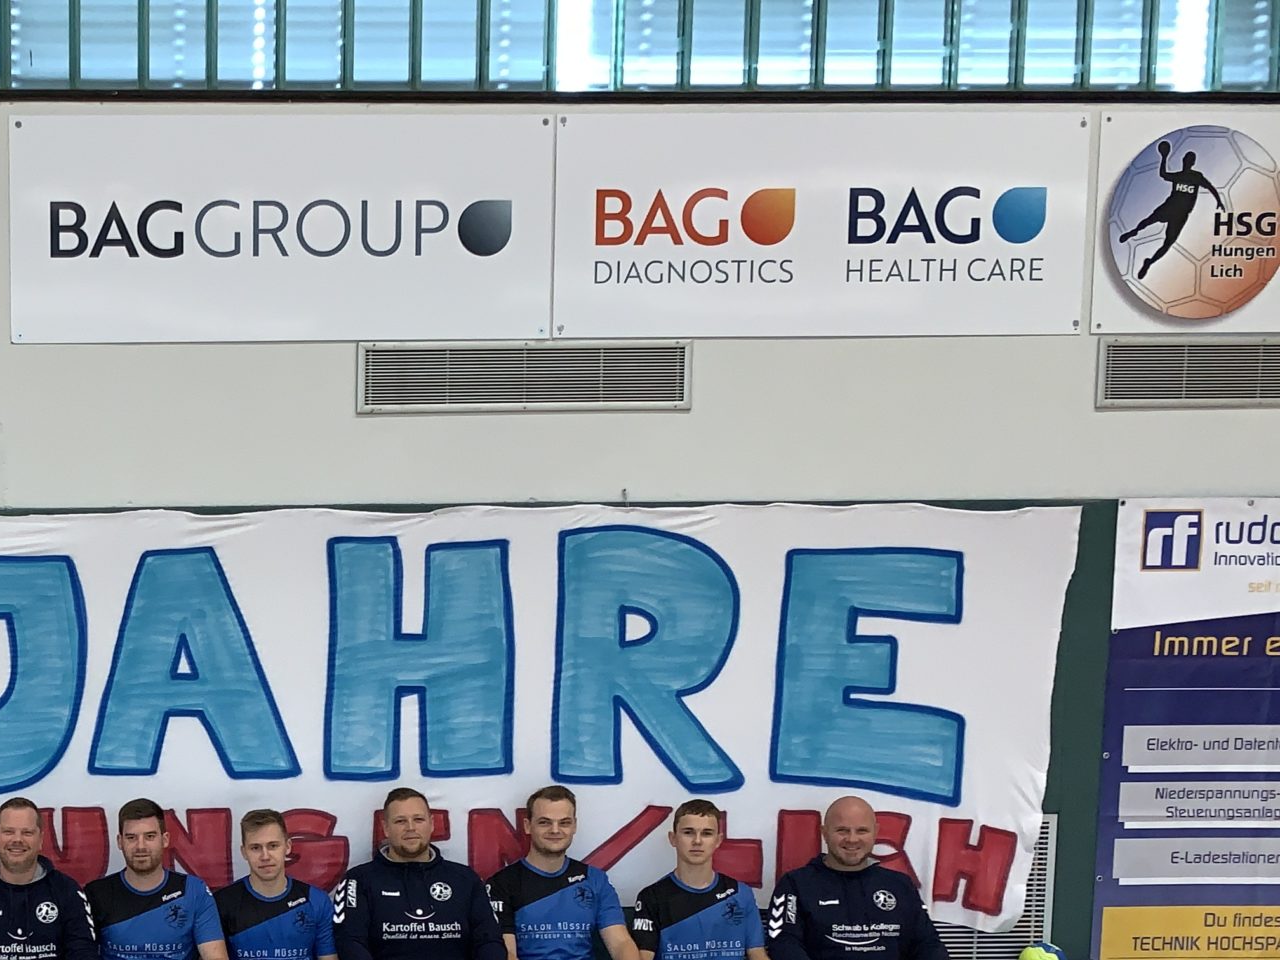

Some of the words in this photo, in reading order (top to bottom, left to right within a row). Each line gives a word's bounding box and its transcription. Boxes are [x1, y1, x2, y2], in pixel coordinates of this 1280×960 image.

[1176, 183, 1196, 194] HSG
[595, 187, 729, 247] BAG
[847, 186, 982, 245] BAG
[1213, 211, 1277, 237] HSG
[1211, 244, 1276, 261] Hungen
[593, 258, 795, 285] DIAGNOSTICS
[846, 258, 958, 283] HEALTH
[966, 257, 1044, 282] CARE
[1210, 264, 1244, 278] Lich
[1145, 514, 1199, 567] rf
[1153, 630, 1252, 657] Immer
[1146, 738, 1199, 751] Elektro-
[1203, 738, 1230, 751] und
[1154, 786, 1280, 802] Niederspannungs-
[382, 922, 426, 932] Kartoffel
[428, 921, 462, 932] Bausch
[1203, 912, 1228, 928] Du
[666, 943, 700, 952] SALON
[1131, 936, 1201, 952] TECHNIK
[237, 948, 268, 958] SALON
